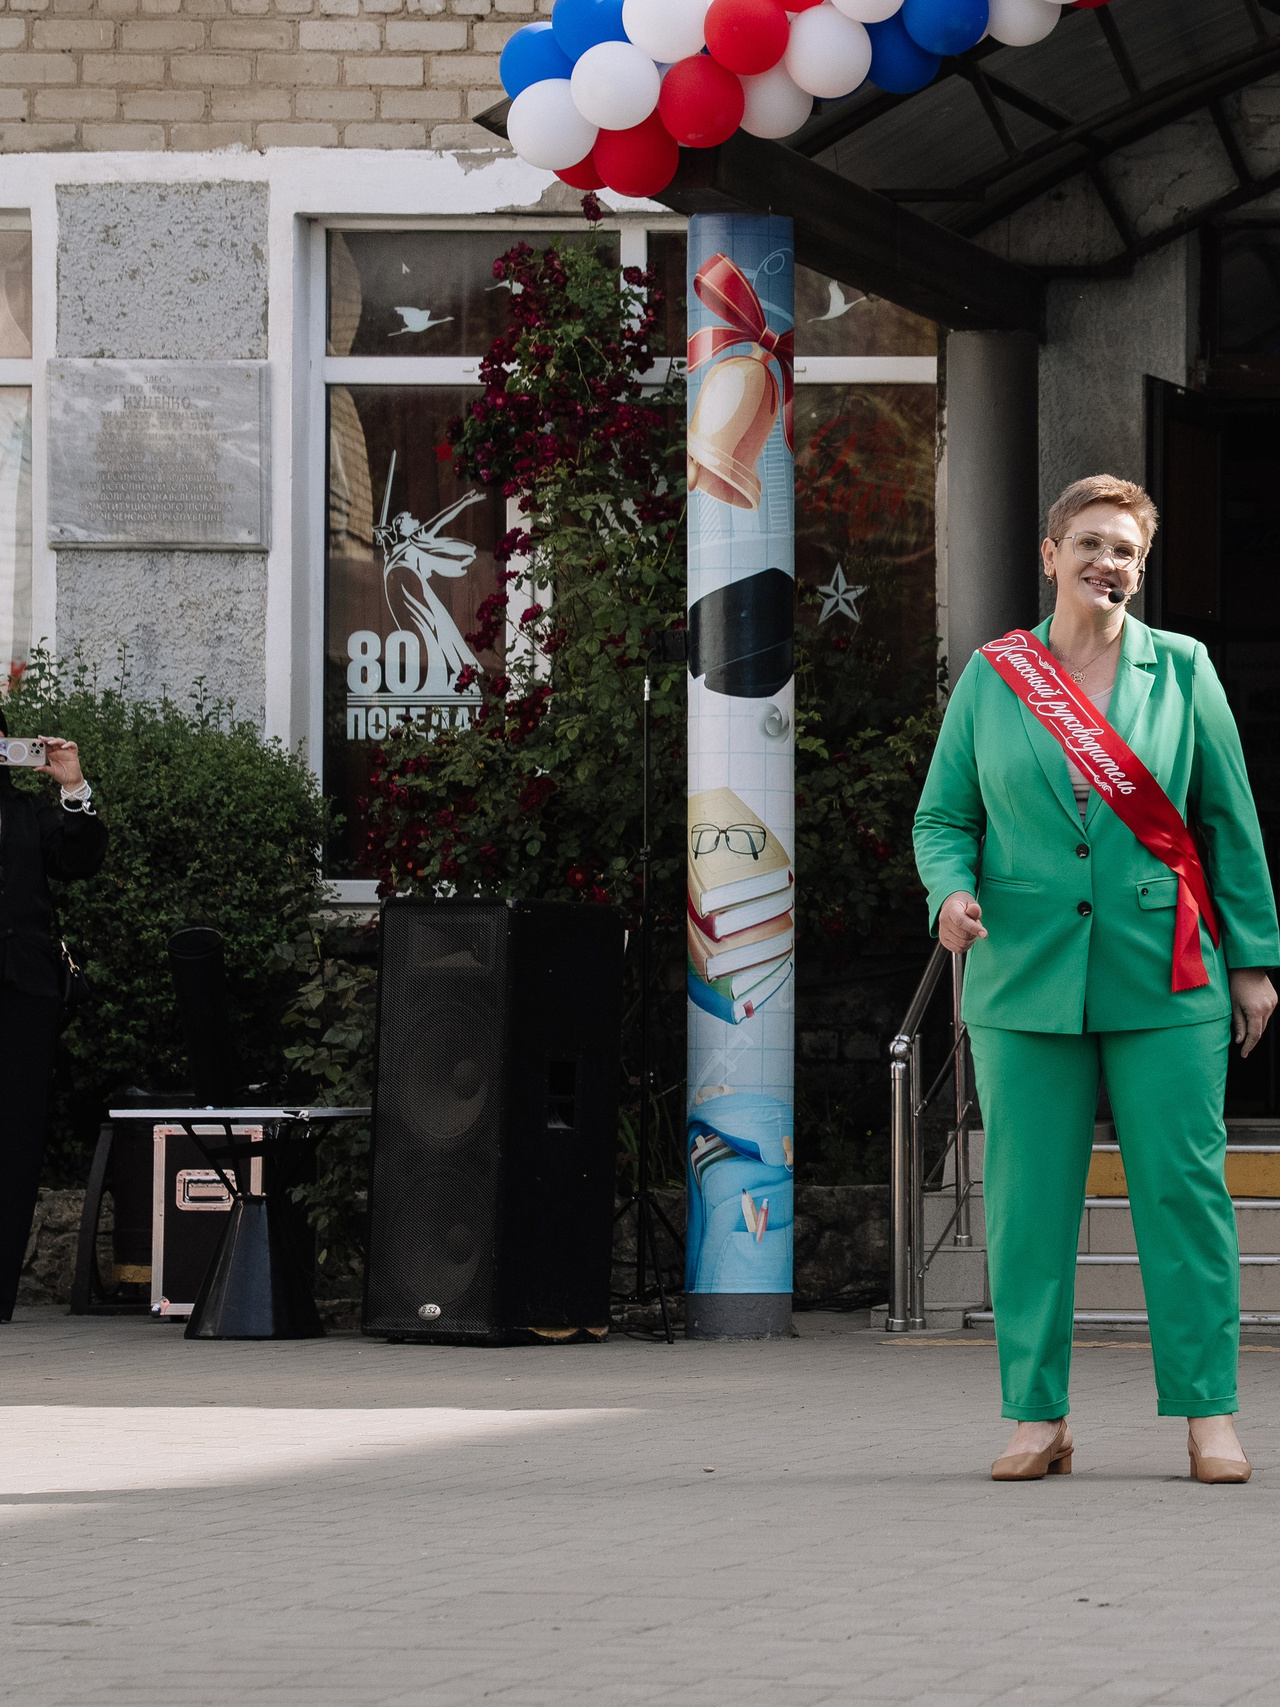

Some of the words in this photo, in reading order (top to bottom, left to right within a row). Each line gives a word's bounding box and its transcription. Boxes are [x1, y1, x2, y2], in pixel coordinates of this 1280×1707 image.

[123, 396, 191, 410] КУЦЕНКО
[143, 376, 171, 384] ЗДЕСЬ
[347, 630, 420, 694] 80
[981, 633, 1061, 705] Классный
[1028, 691, 1137, 796] руководитель
